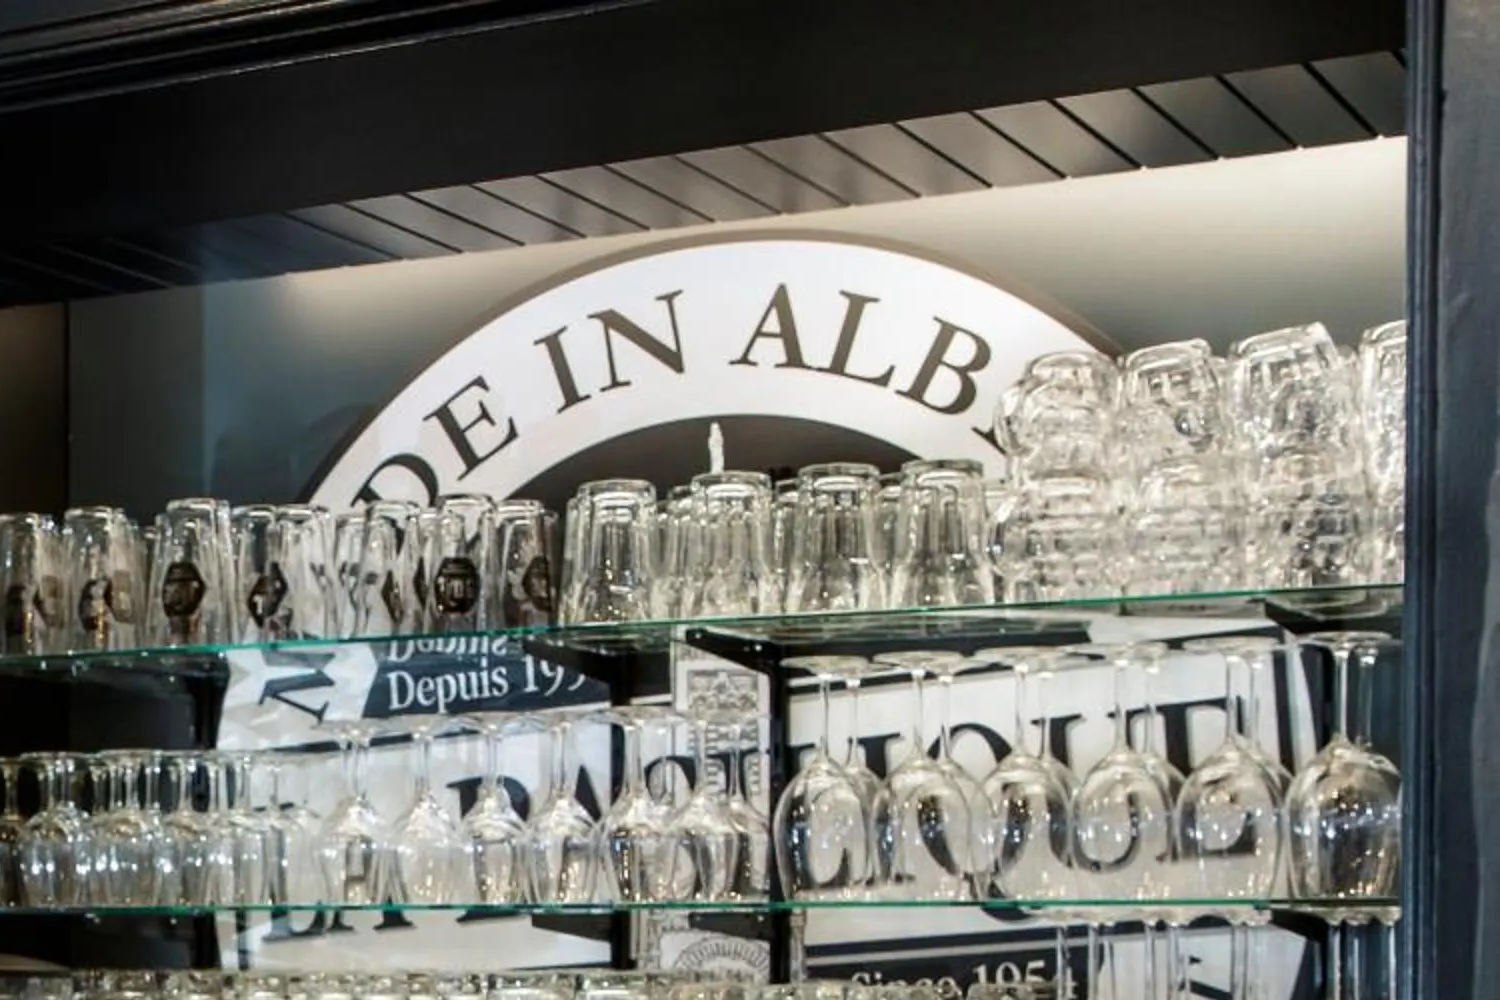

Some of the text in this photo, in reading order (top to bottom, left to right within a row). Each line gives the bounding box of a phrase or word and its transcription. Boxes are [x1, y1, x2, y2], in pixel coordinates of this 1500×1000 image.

[533, 289, 685, 414] IN
[729, 282, 1006, 455] ALB
[387, 656, 509, 714] Depuis
